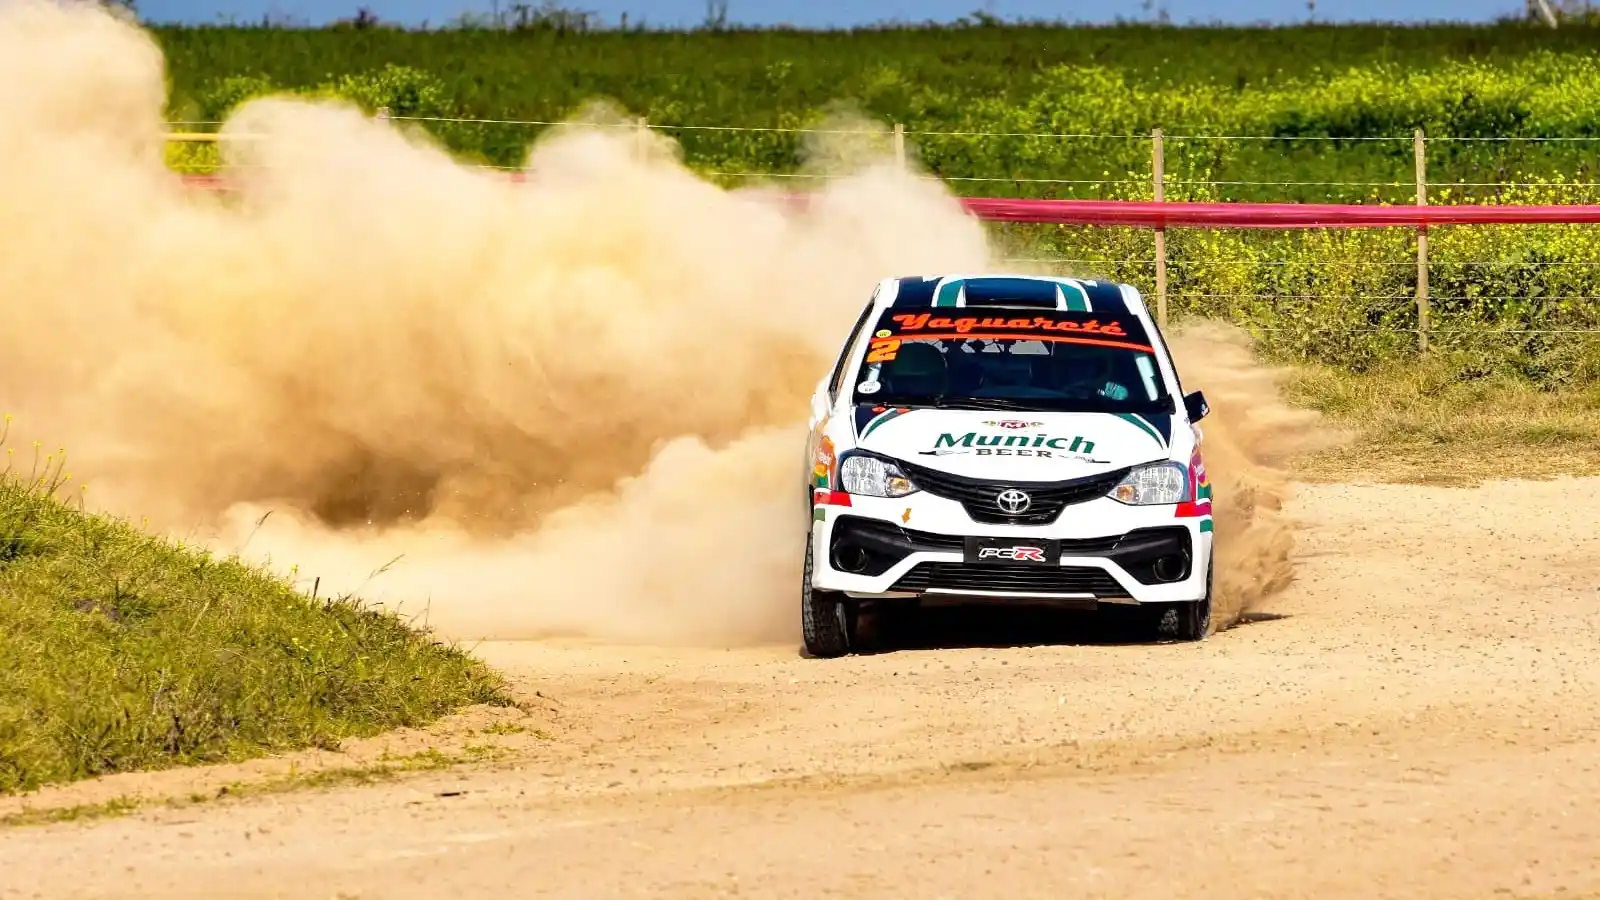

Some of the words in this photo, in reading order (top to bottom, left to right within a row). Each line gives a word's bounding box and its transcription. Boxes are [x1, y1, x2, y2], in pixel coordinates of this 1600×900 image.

[892, 313, 1127, 336] Yaguareté
[866, 339, 902, 363] 2
[934, 432, 1096, 454] Munich
[975, 448, 1053, 458] BEER
[978, 546, 1046, 562] PCR
